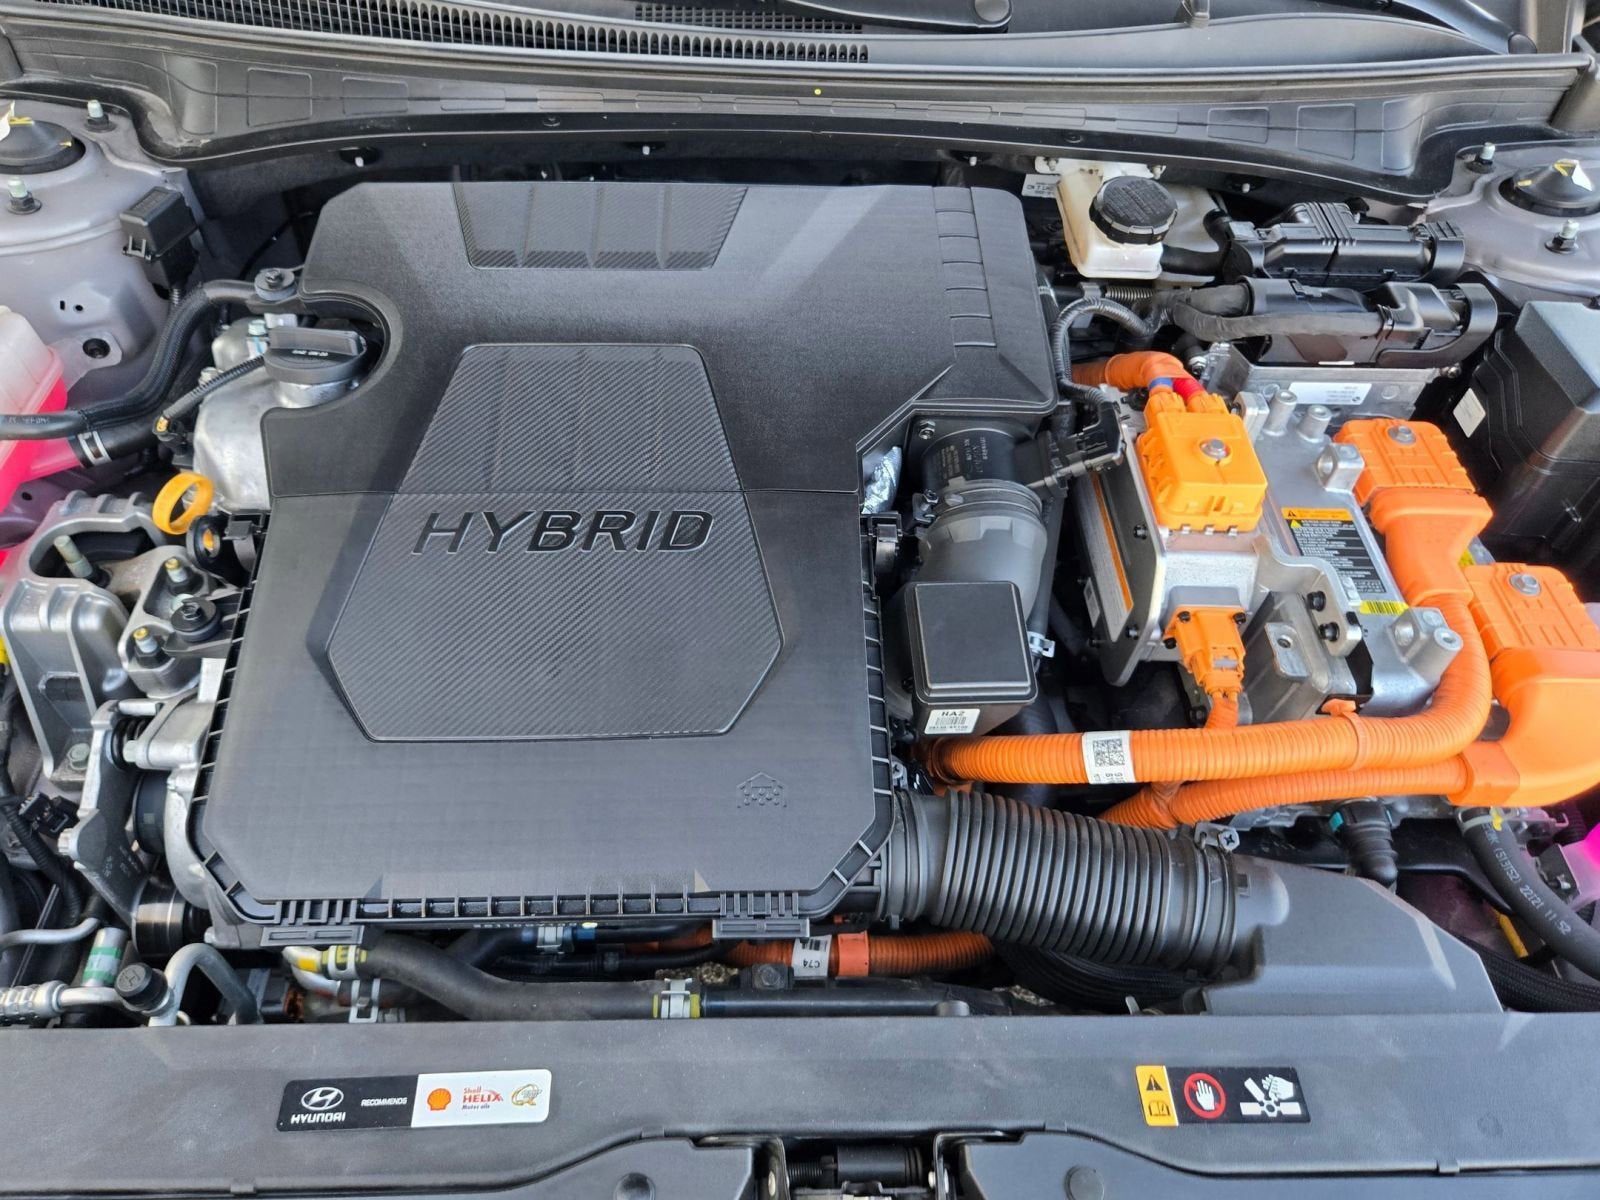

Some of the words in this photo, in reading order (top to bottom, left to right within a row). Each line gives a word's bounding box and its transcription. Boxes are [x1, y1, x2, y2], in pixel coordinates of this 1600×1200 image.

[411, 509, 715, 555] HYBRID
[463, 1085, 482, 1094] Shell
[361, 1098, 407, 1106] RECOMMENDS
[463, 1093, 503, 1103] HELIX
[290, 1111, 346, 1124] HYUNDAI
